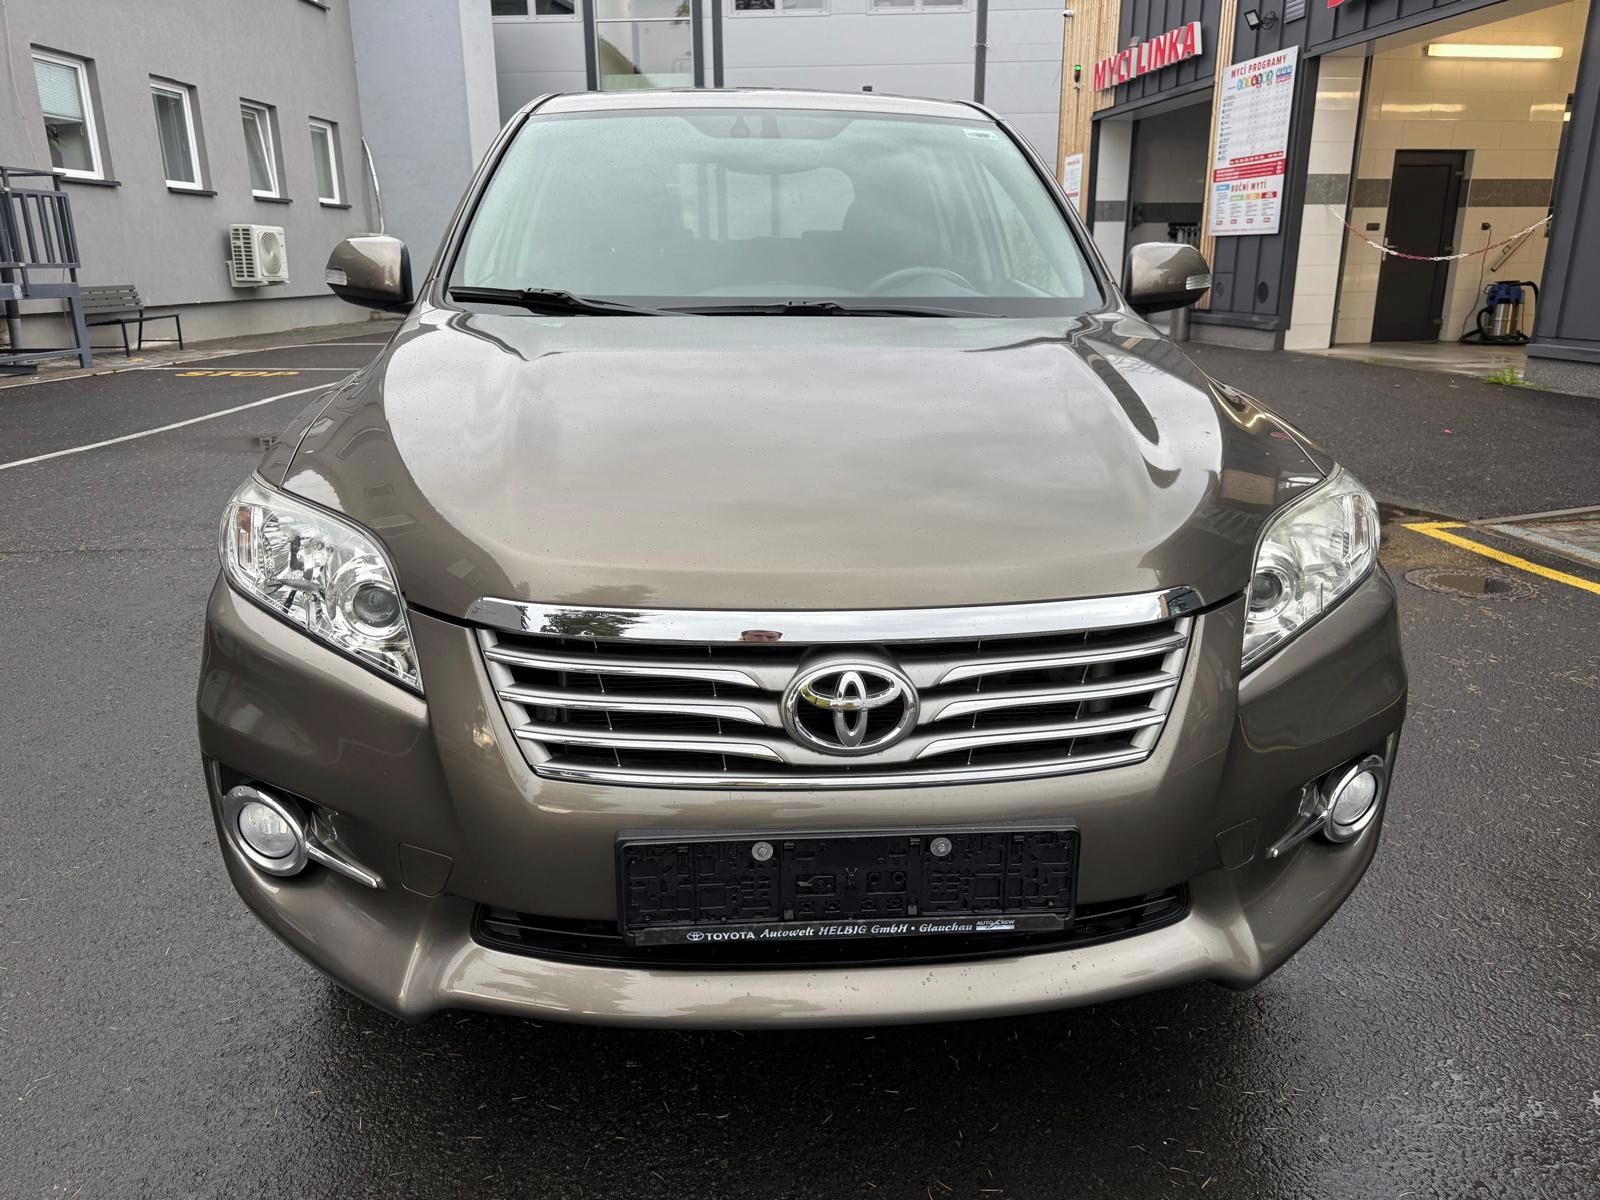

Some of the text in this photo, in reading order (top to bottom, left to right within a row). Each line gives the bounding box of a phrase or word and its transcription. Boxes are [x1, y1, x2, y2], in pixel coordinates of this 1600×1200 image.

[1094, 21, 1201, 92] MYCÍ LINKA
[1248, 54, 1288, 73] PROGRAMY
[705, 931, 755, 941] TOYOTA
[760, 926, 814, 938] Autowelt
[818, 925, 867, 936] HELBIG
[871, 924, 909, 934] GmbH
[919, 922, 973, 932] Glauchau
